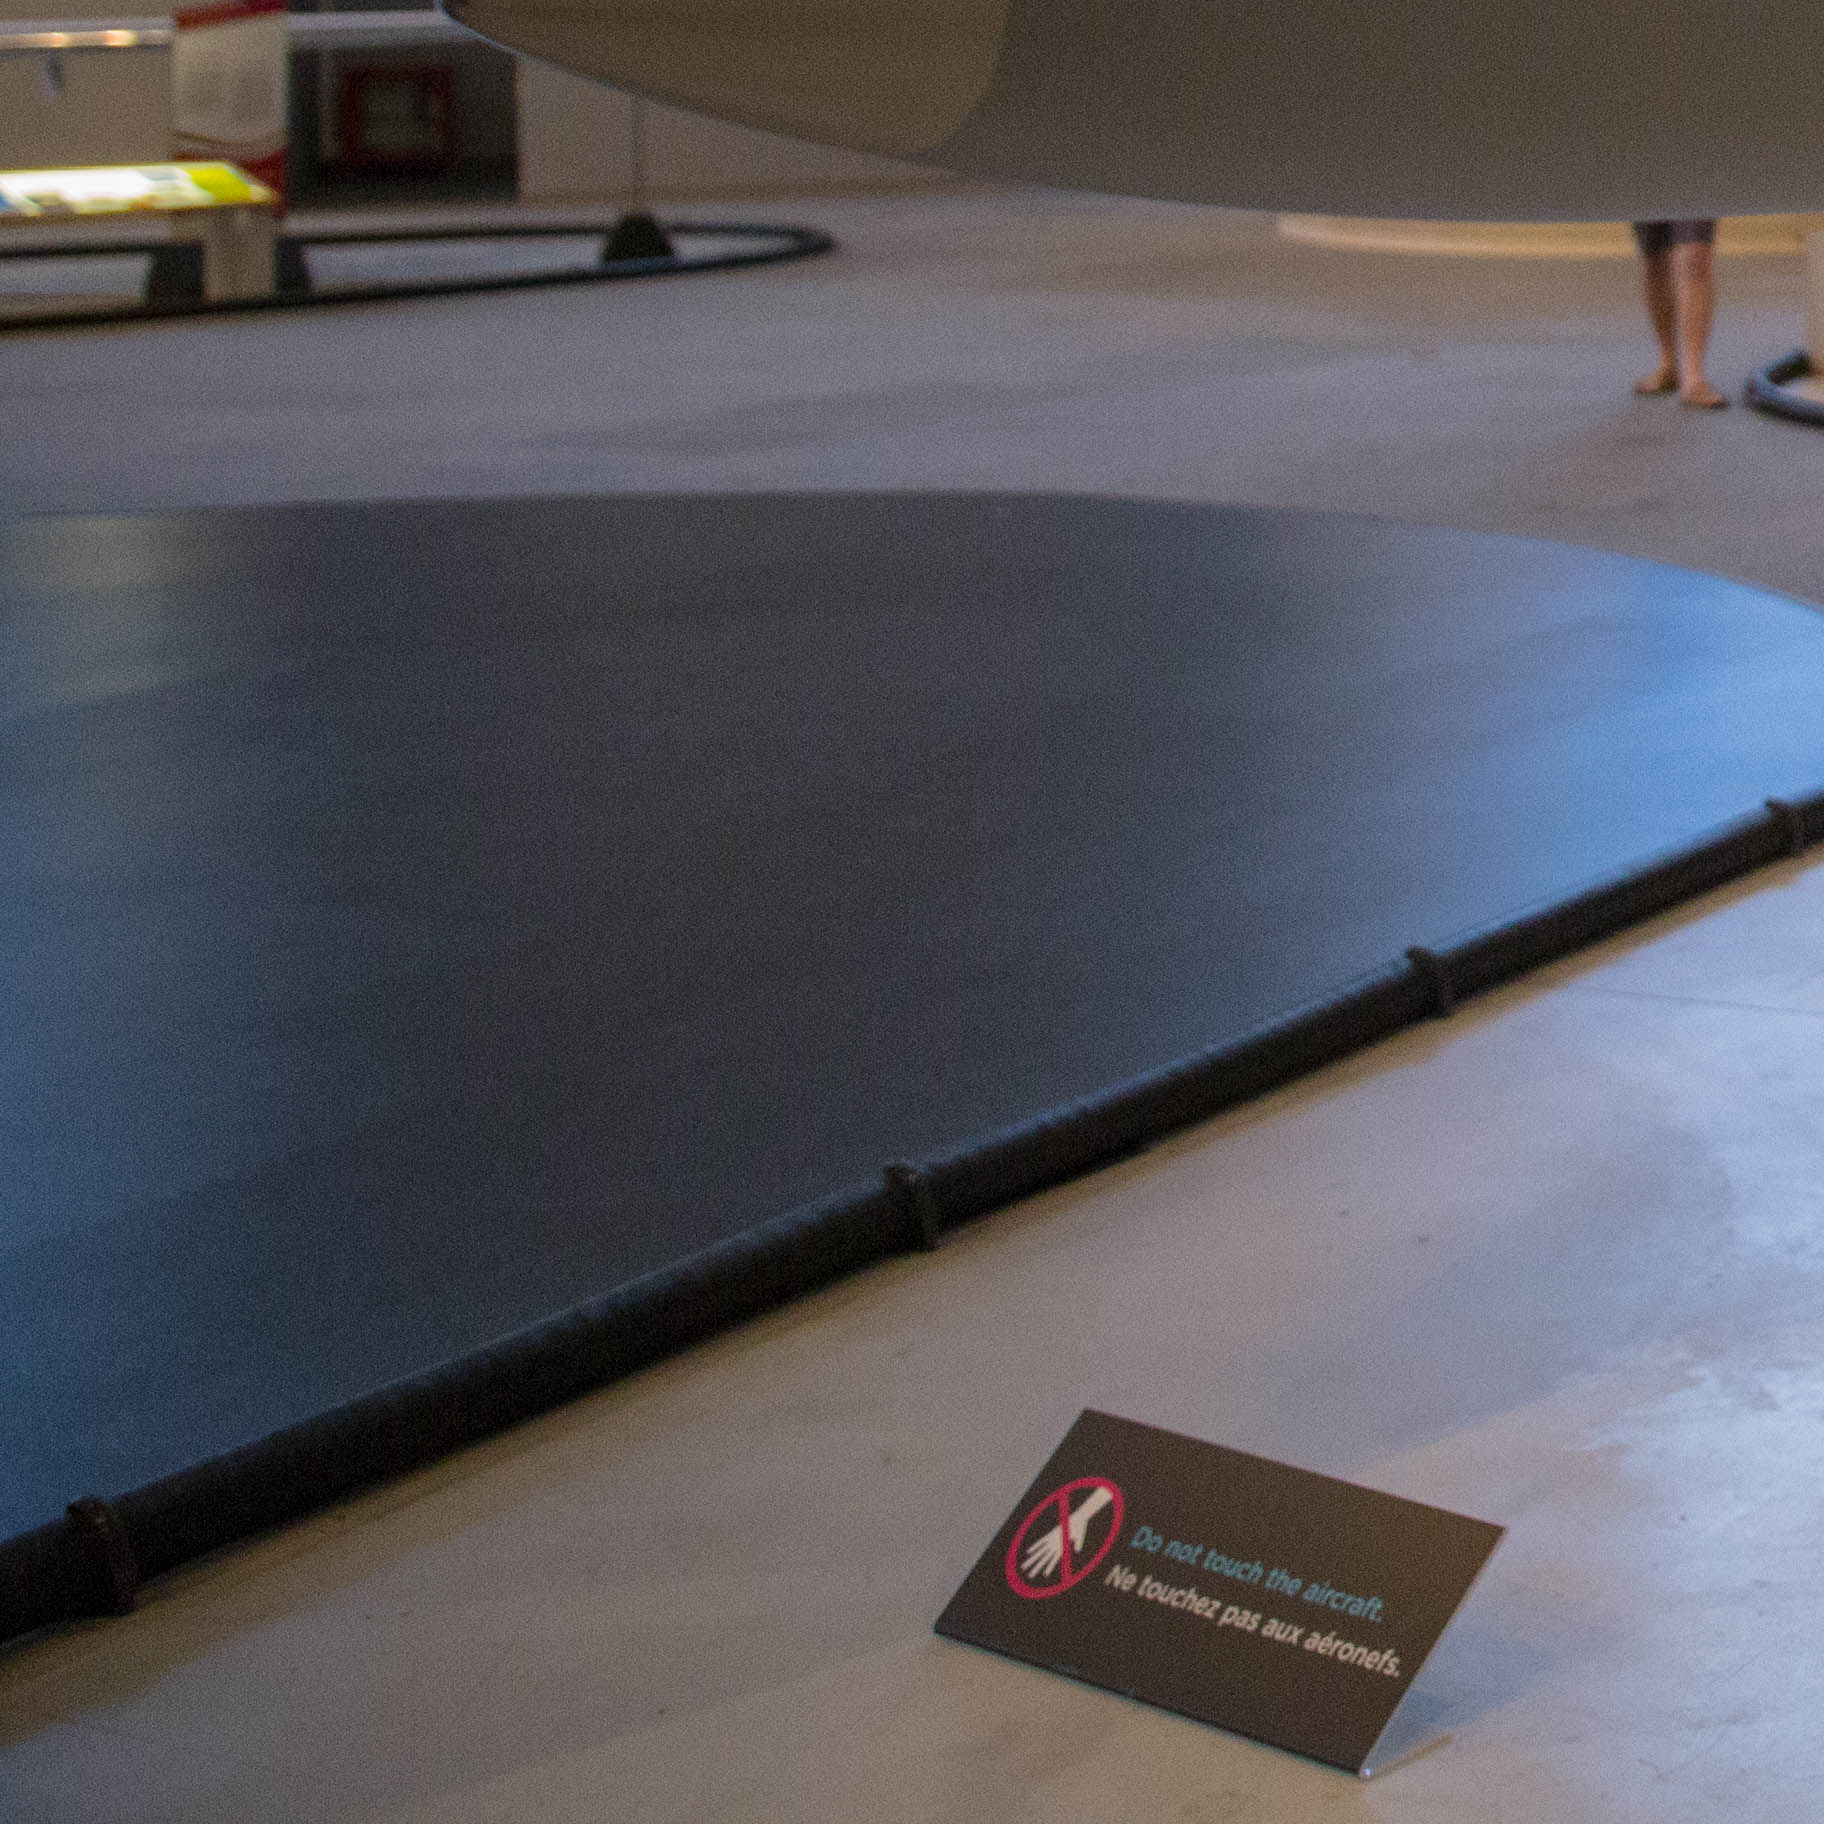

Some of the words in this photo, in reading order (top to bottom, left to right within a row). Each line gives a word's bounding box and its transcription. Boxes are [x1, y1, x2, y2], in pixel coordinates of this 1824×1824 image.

[1104, 1563, 1139, 1590] Ne
[1138, 1574, 1221, 1618] touchez
[1218, 1604, 1262, 1632] pas
[1261, 1617, 1305, 1645] aux
[1304, 1627, 1402, 1677] aéronefs.
[1131, 1526, 1163, 1552] Do
[1164, 1539, 1204, 1564] not
[1203, 1547, 1263, 1584] touch
[1265, 1568, 1302, 1596] the
[1303, 1580, 1384, 1623] aircraft.
